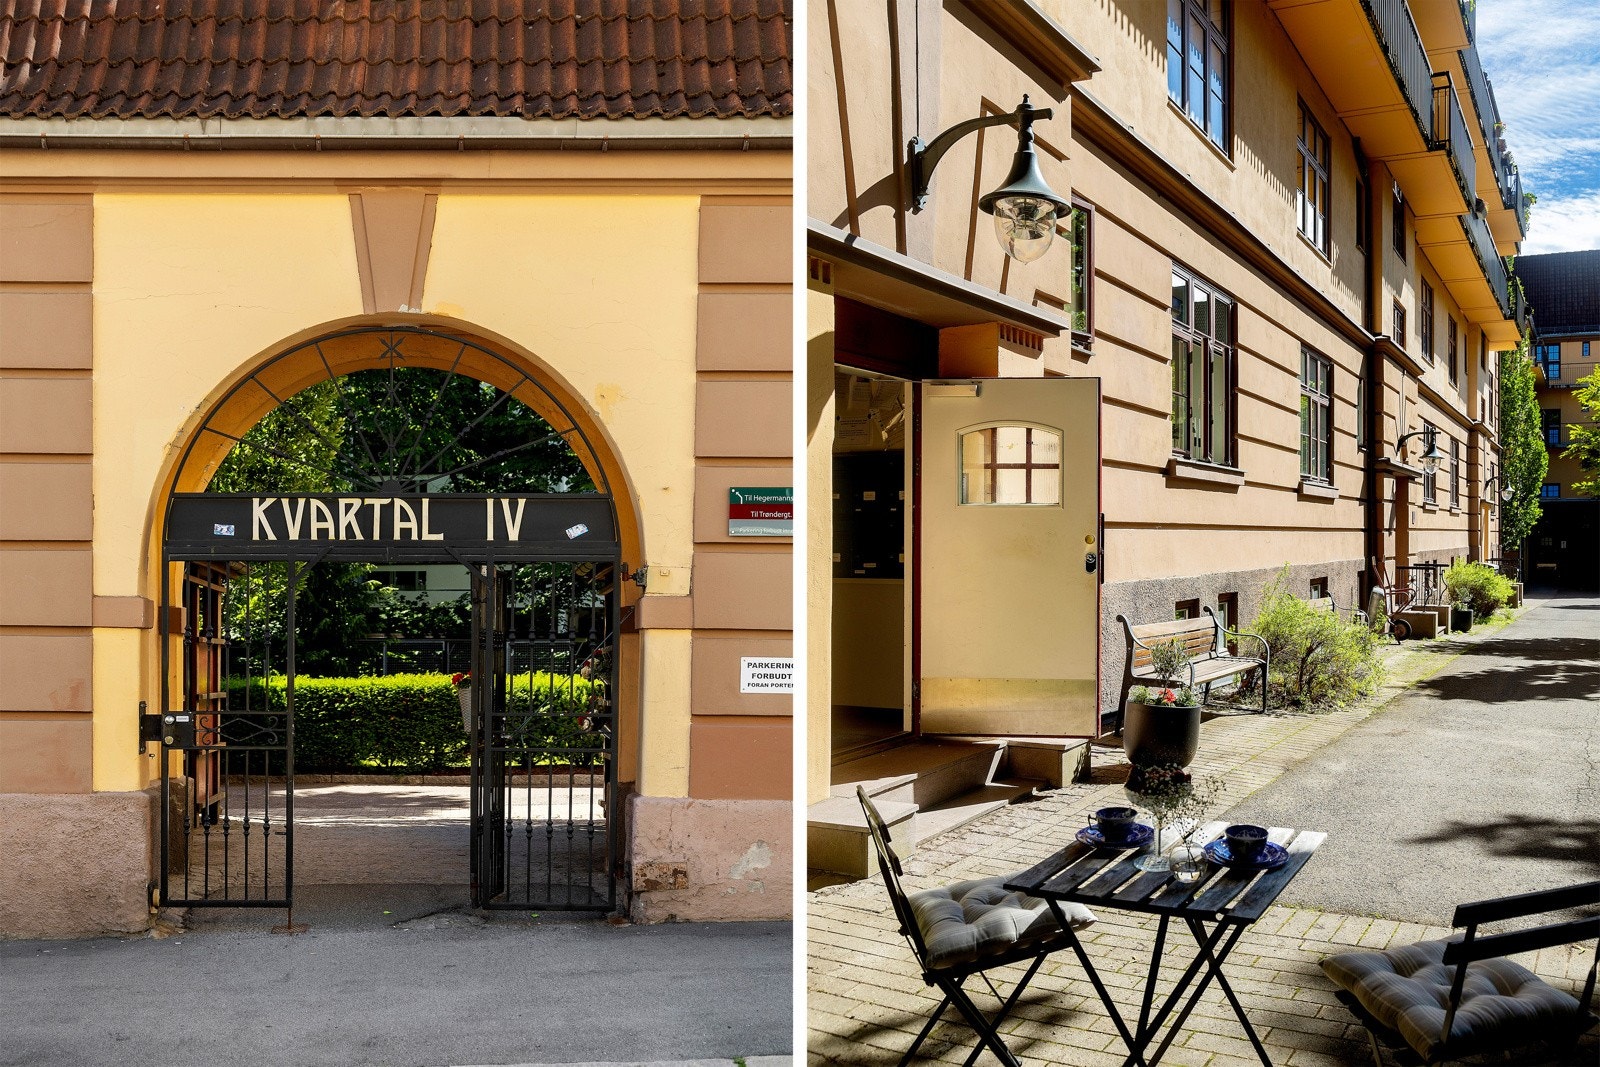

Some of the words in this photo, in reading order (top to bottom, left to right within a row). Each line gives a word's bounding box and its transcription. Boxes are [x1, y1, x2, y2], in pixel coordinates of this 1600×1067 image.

[252, 497, 444, 541] KVARTAL
[486, 498, 527, 541] IV
[751, 672, 793, 680] FORBUDT
